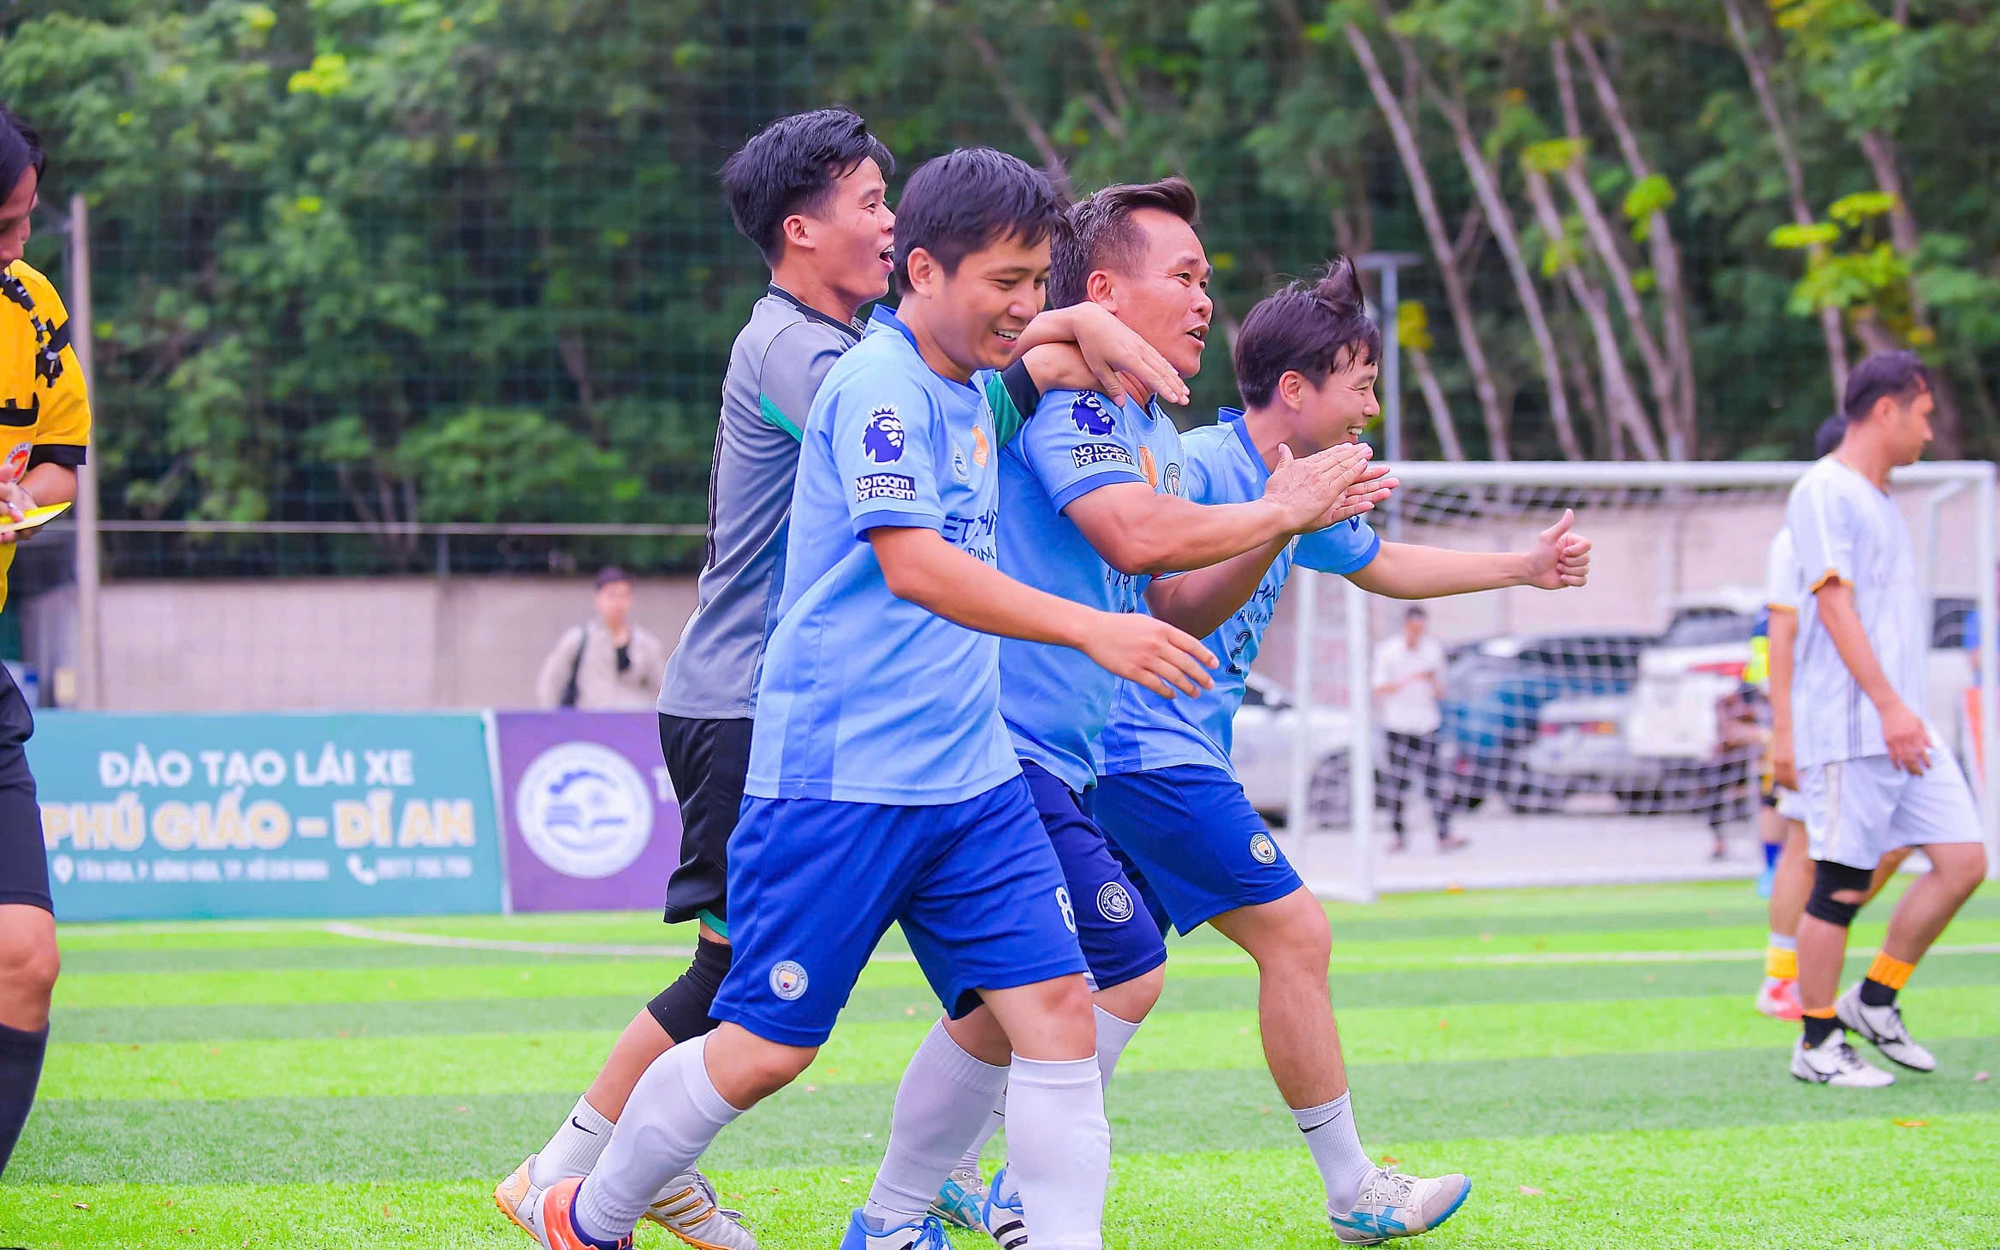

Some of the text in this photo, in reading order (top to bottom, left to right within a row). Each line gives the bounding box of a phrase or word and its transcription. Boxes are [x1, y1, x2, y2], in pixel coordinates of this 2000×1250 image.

[1071, 446, 1093, 459] No
[1095, 452, 1135, 466] racism
[856, 475, 910, 490] No room
[871, 486, 917, 501] racism
[99, 741, 415, 790] ĐÀO TẠO LÁI XE
[153, 784, 292, 851] GIÁO
[397, 798, 476, 848] AN
[1055, 886, 1076, 934] 8
